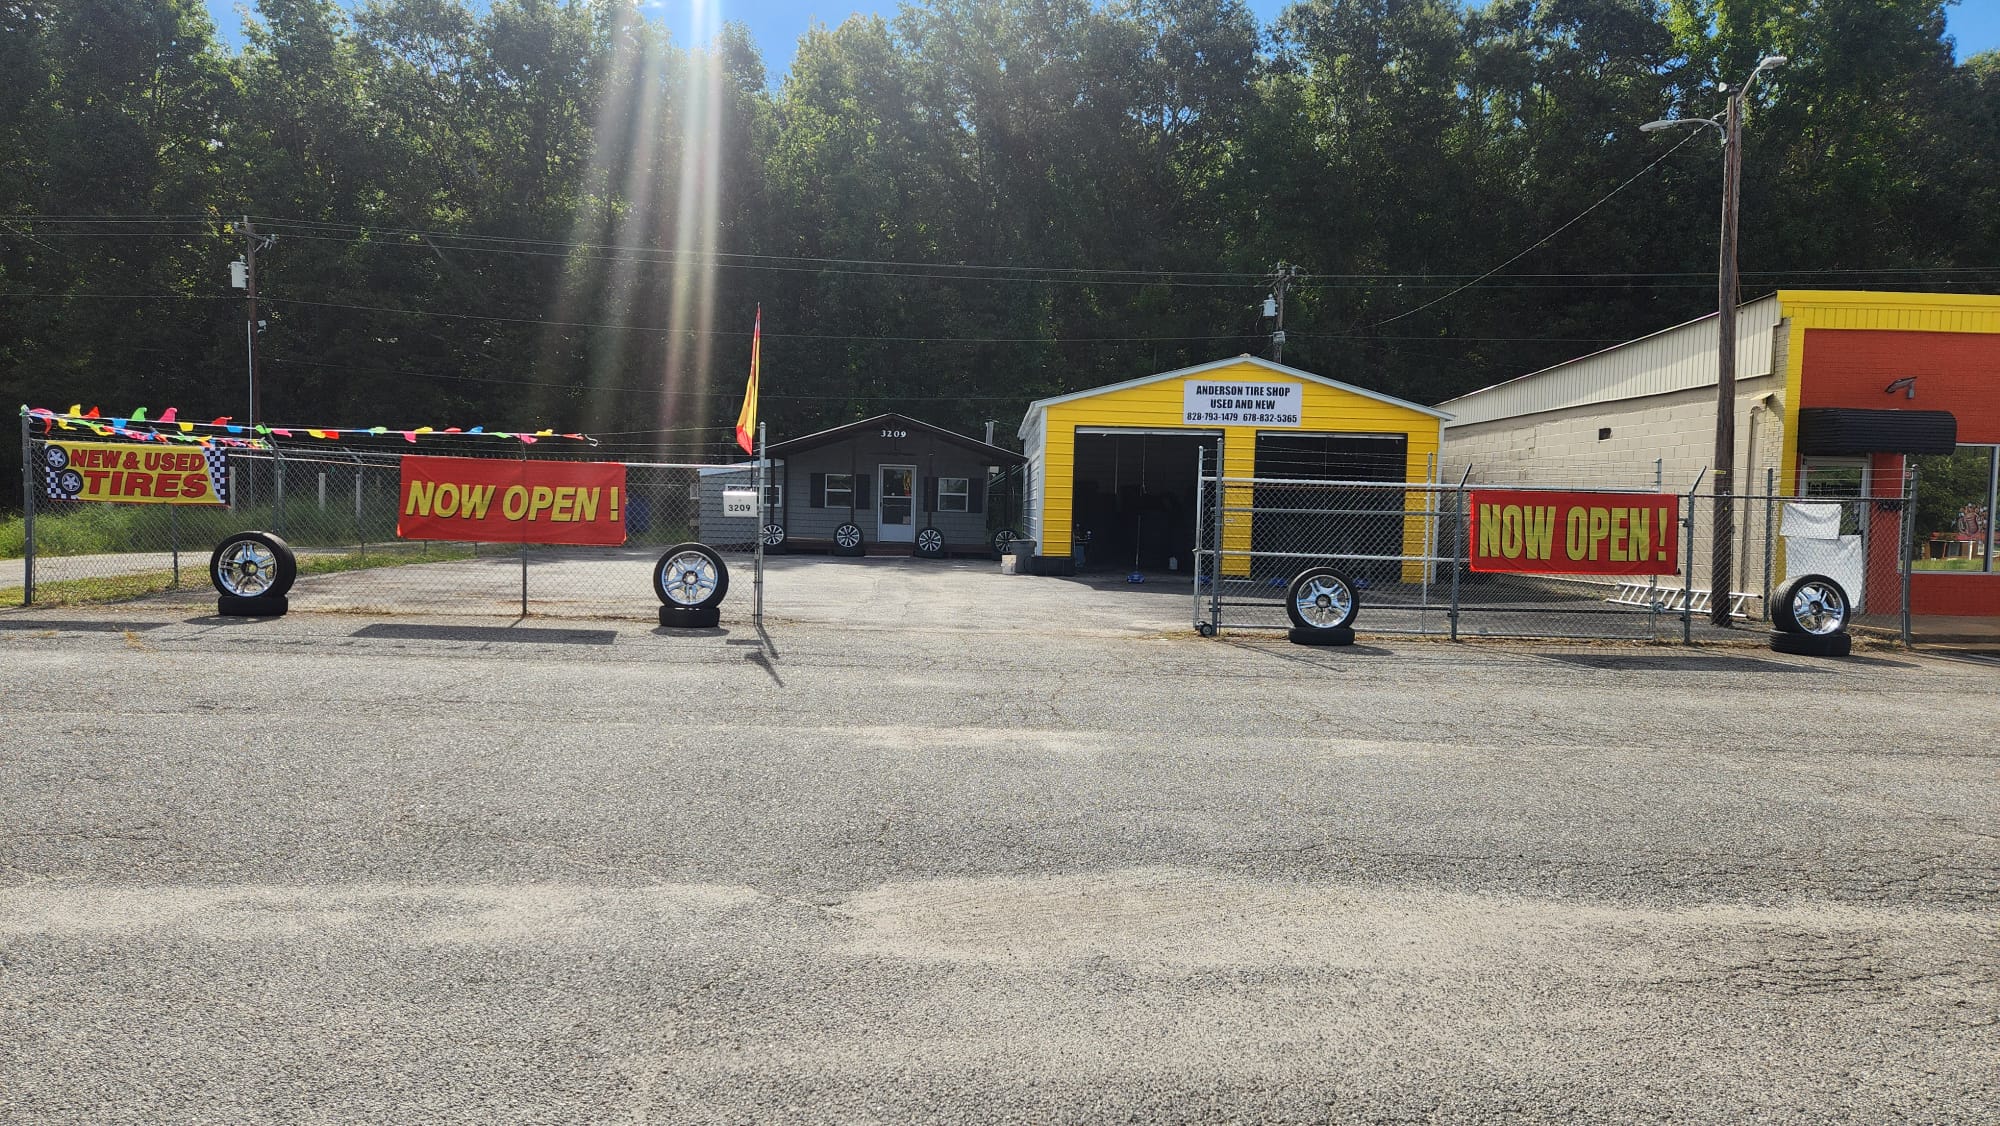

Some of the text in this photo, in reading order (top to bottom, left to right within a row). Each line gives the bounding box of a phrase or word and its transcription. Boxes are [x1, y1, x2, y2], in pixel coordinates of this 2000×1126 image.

[1195, 385, 1291, 397] ANDERSON TIRE SHOP
[1210, 399, 1276, 410] USED AND NEW
[1186, 412, 1298, 423] 828-793-1479 678-832-5365
[880, 429, 907, 438] 3209
[70, 449, 205, 472] NEW & USED
[84, 470, 209, 498] TIRES
[405, 480, 496, 519] NOW
[728, 504, 751, 512] 3209
[1478, 503, 1557, 560] NOW
